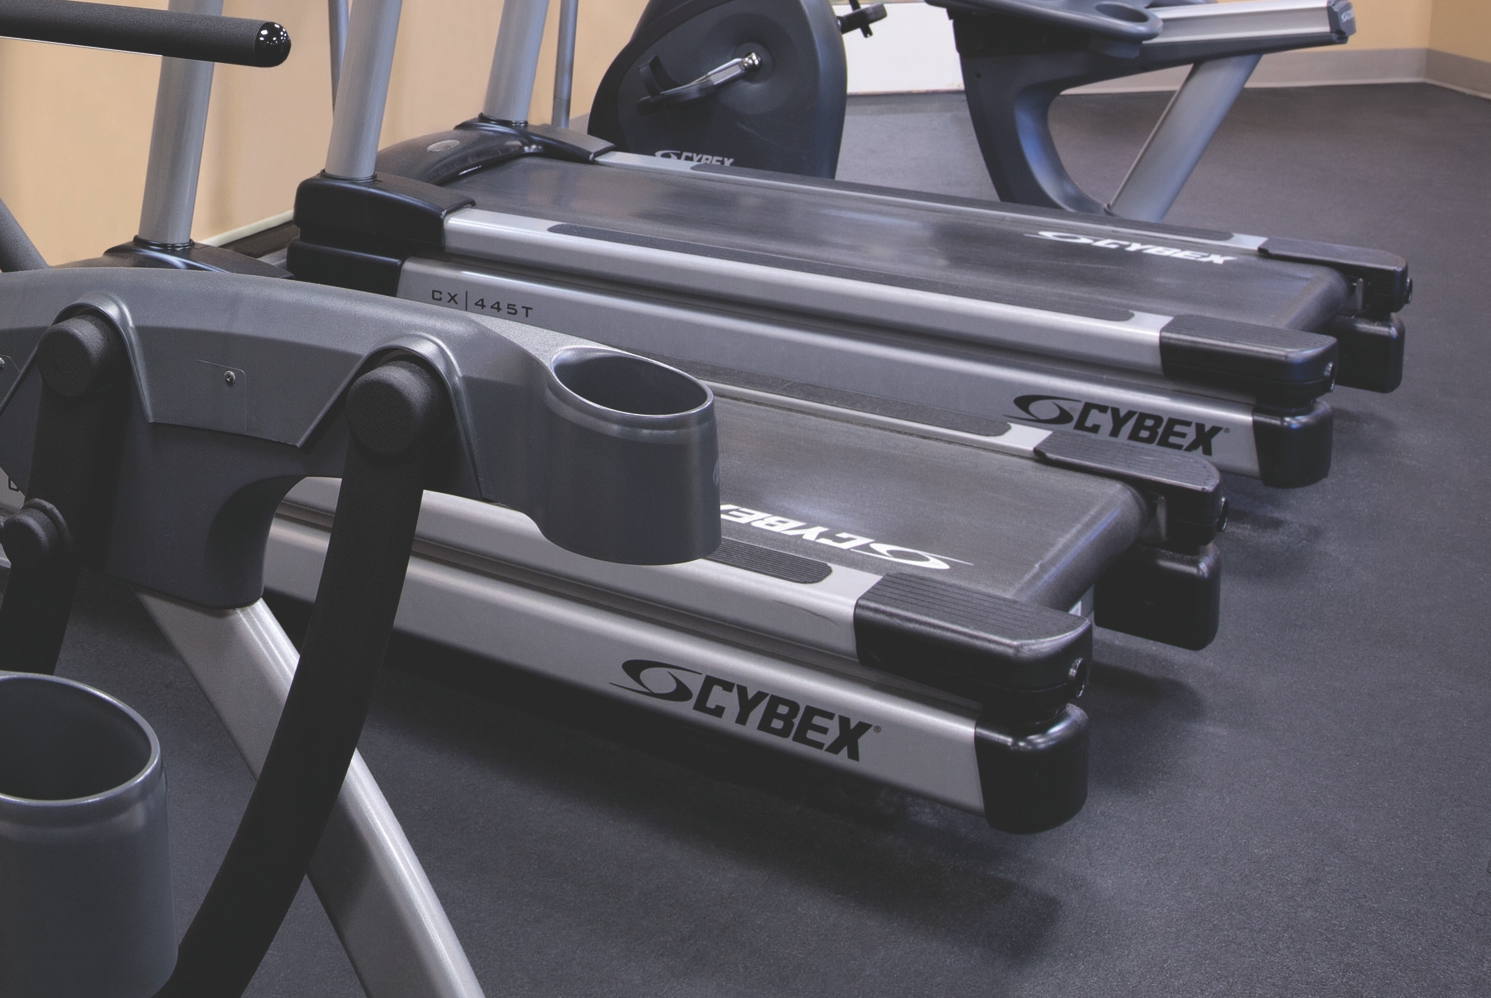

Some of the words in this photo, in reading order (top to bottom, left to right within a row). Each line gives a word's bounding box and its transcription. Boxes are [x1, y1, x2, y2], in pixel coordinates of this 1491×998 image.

[1091, 238, 1238, 265] CYBEX
[1073, 401, 1224, 457] CYBEX
[692, 674, 874, 763] CYBEX
